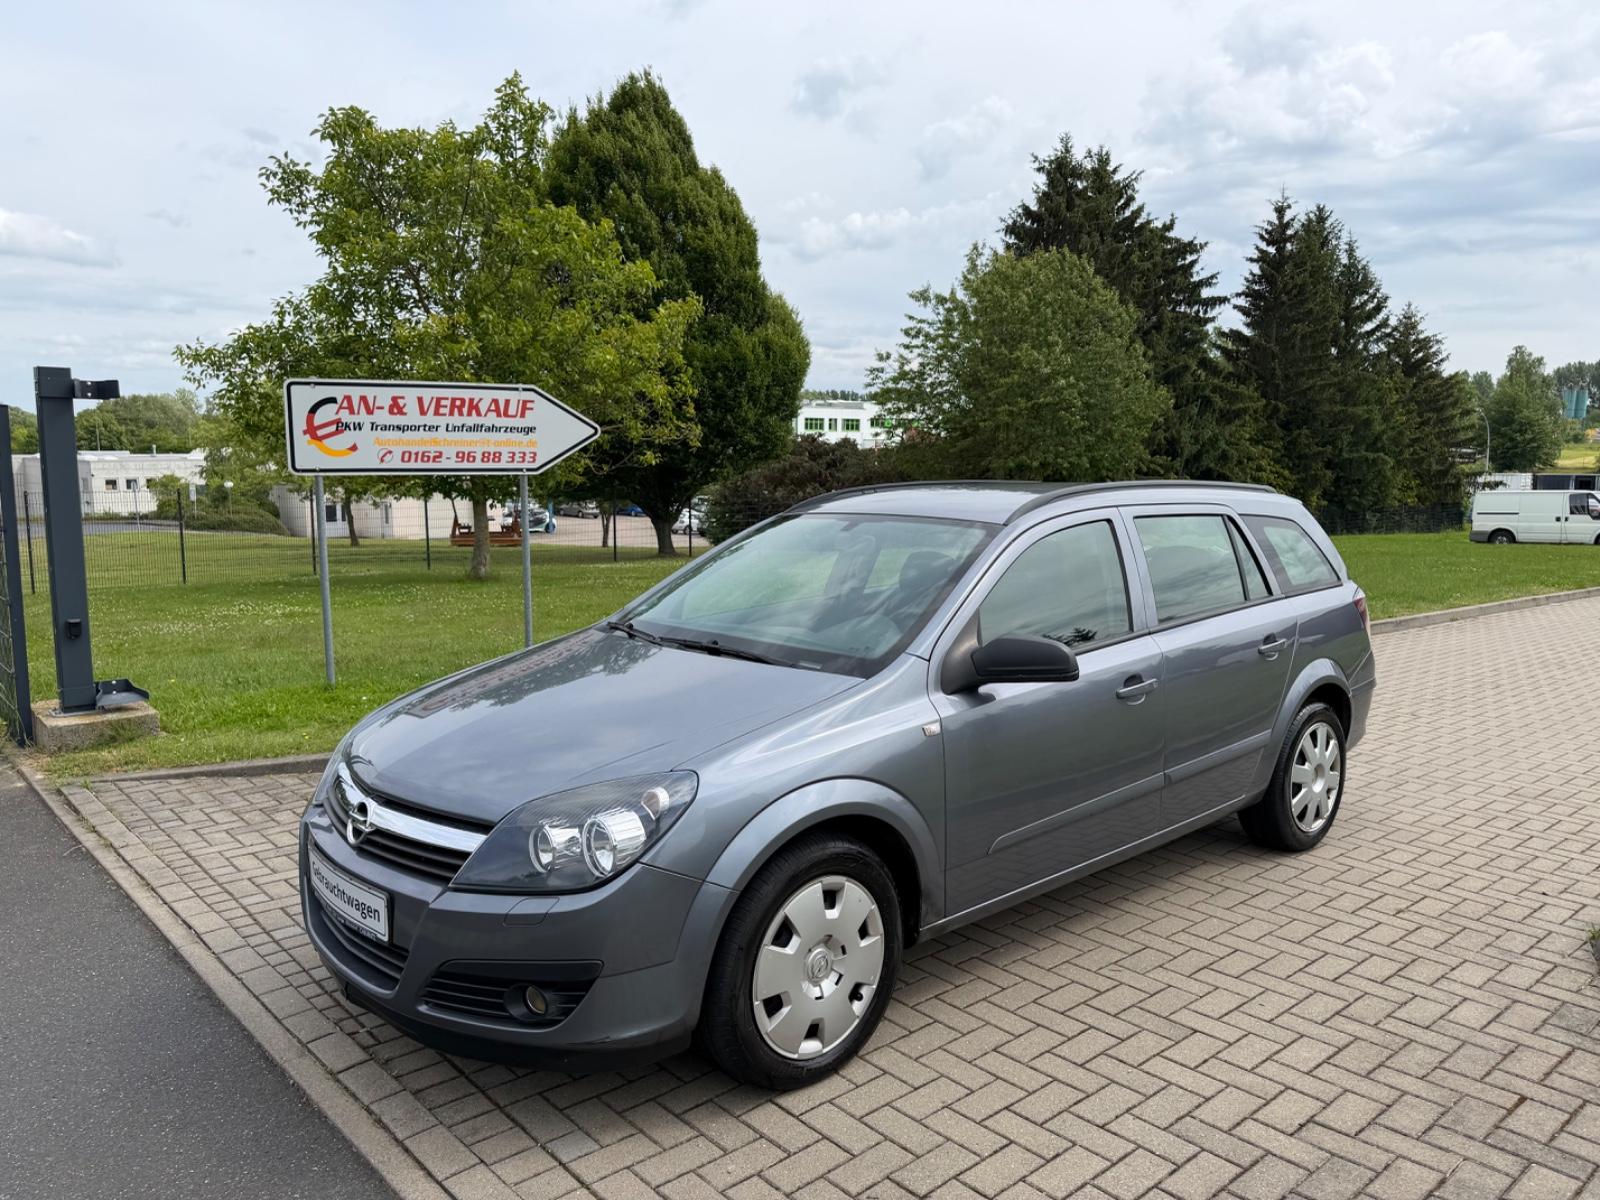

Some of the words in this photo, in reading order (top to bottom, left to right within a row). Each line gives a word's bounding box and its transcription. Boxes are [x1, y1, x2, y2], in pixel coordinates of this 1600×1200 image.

[416, 396, 535, 419] VERKAUF
[335, 421, 365, 432] PKW
[369, 422, 441, 434] Transporter
[445, 423, 537, 435] Unfallfahrzeuge
[480, 451, 503, 464] 88
[505, 451, 538, 465] 333
[312, 861, 381, 923] Gebrauchtwagen
